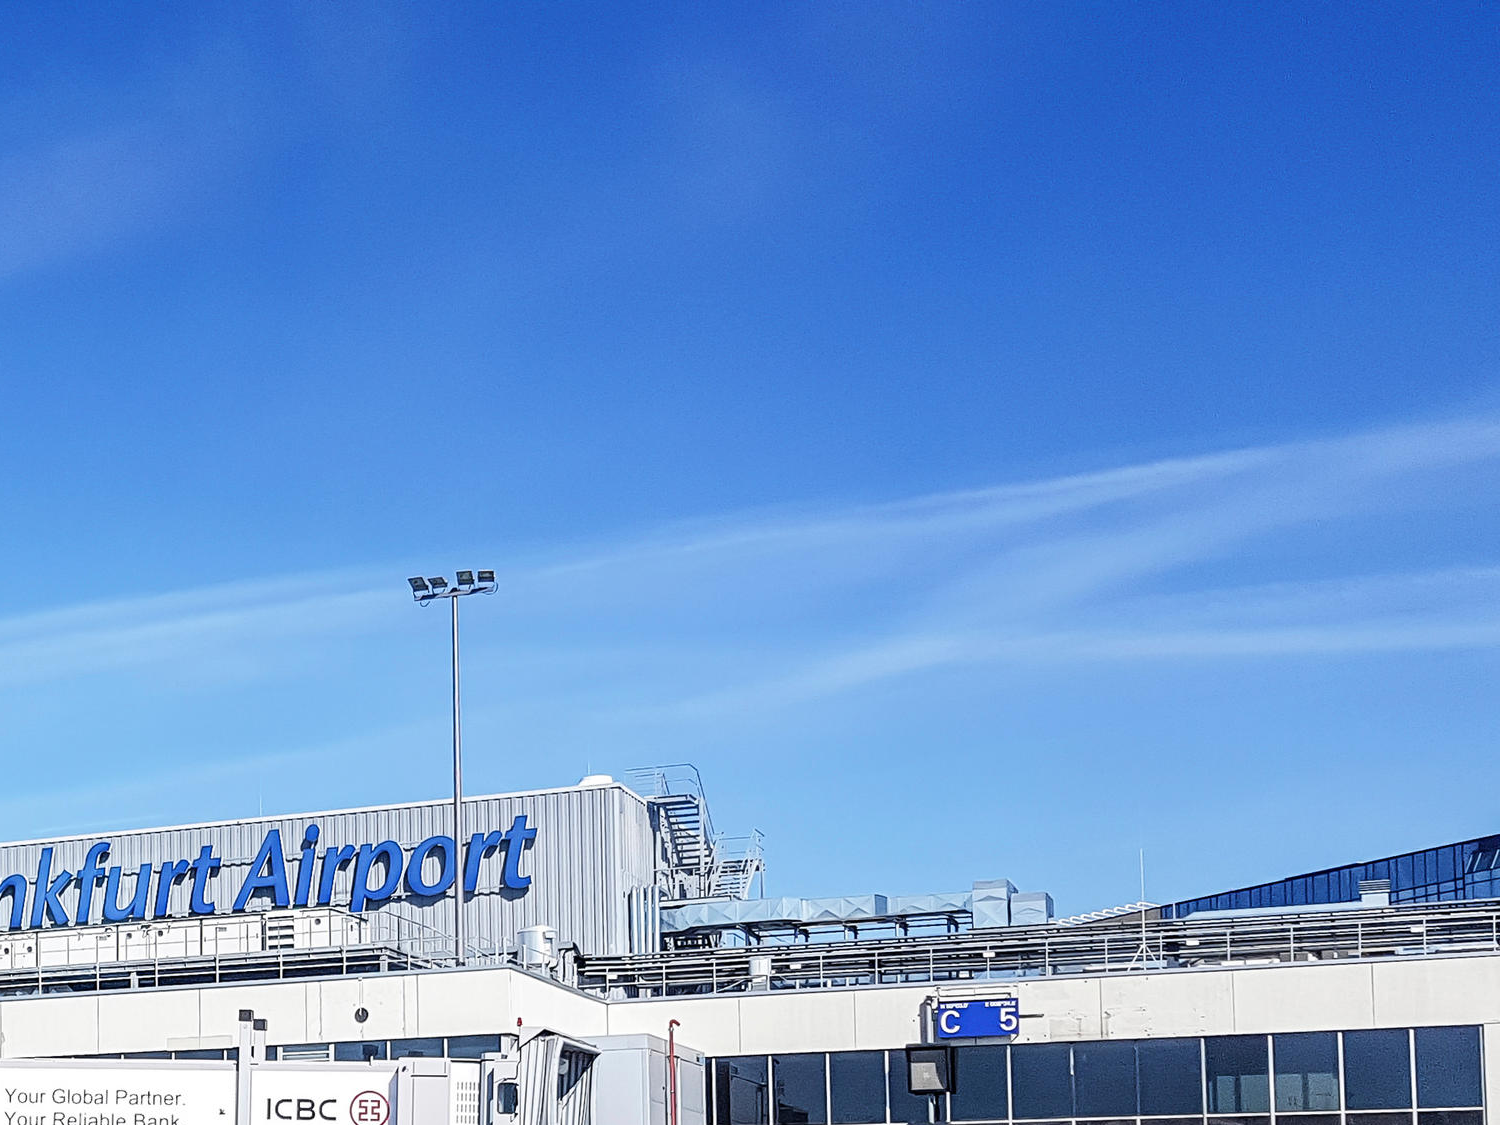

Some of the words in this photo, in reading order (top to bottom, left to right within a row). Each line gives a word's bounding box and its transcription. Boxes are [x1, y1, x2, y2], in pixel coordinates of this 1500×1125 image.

[232, 815, 537, 913] Airport
[940, 1010, 960, 1034] C
[999, 1007, 1018, 1031] 5
[5, 1088, 46, 1103] Your
[52, 1088, 109, 1105] Global
[115, 1090, 186, 1106] Partner.
[266, 1098, 337, 1121] ICBC
